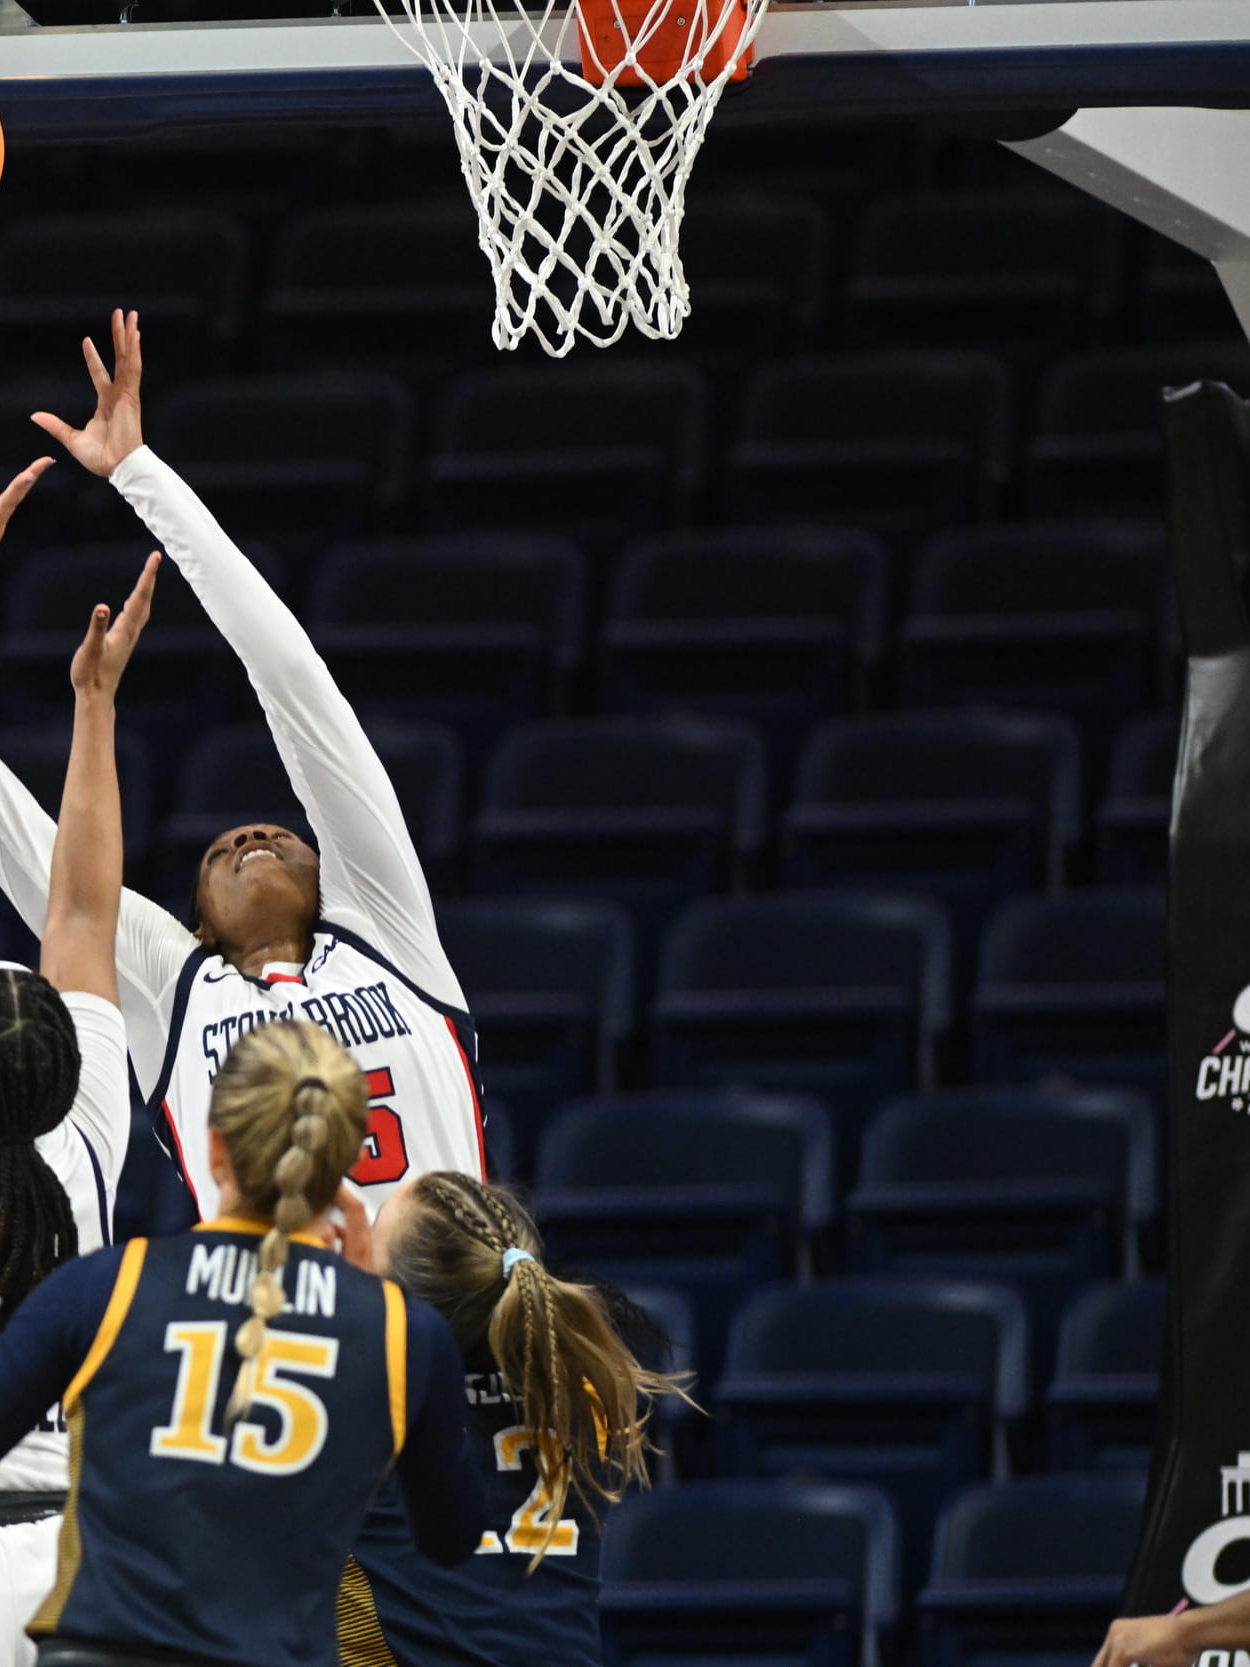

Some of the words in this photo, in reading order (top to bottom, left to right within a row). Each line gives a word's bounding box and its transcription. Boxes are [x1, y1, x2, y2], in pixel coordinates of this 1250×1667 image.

[300, 981, 413, 1048] BROOK
[343, 1066, 410, 1187] 5
[149, 1320, 340, 1476] 15
